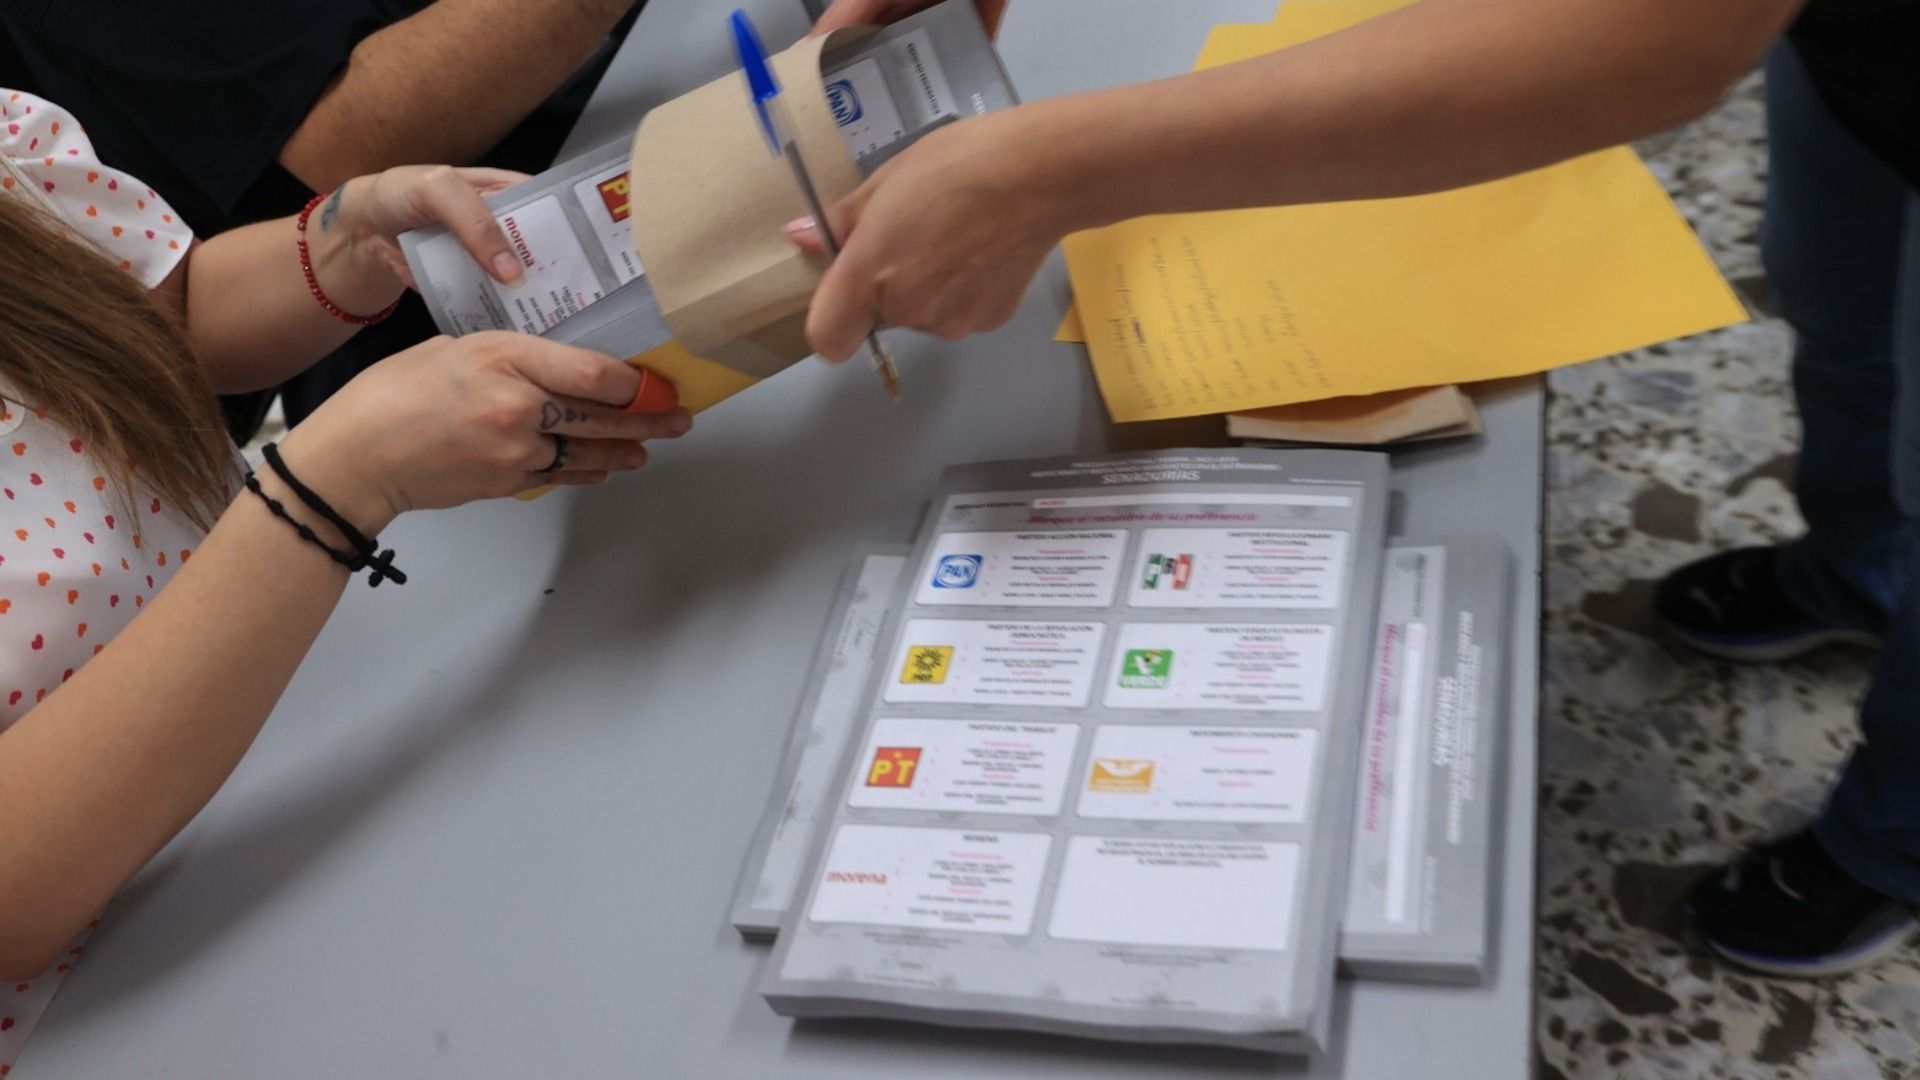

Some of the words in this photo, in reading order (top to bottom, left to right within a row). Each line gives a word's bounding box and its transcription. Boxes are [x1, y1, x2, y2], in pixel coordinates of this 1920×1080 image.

[504, 216, 536, 268] morena
[943, 563, 972, 579] PAN
[869, 759, 916, 785] PT
[826, 871, 888, 886] morena
